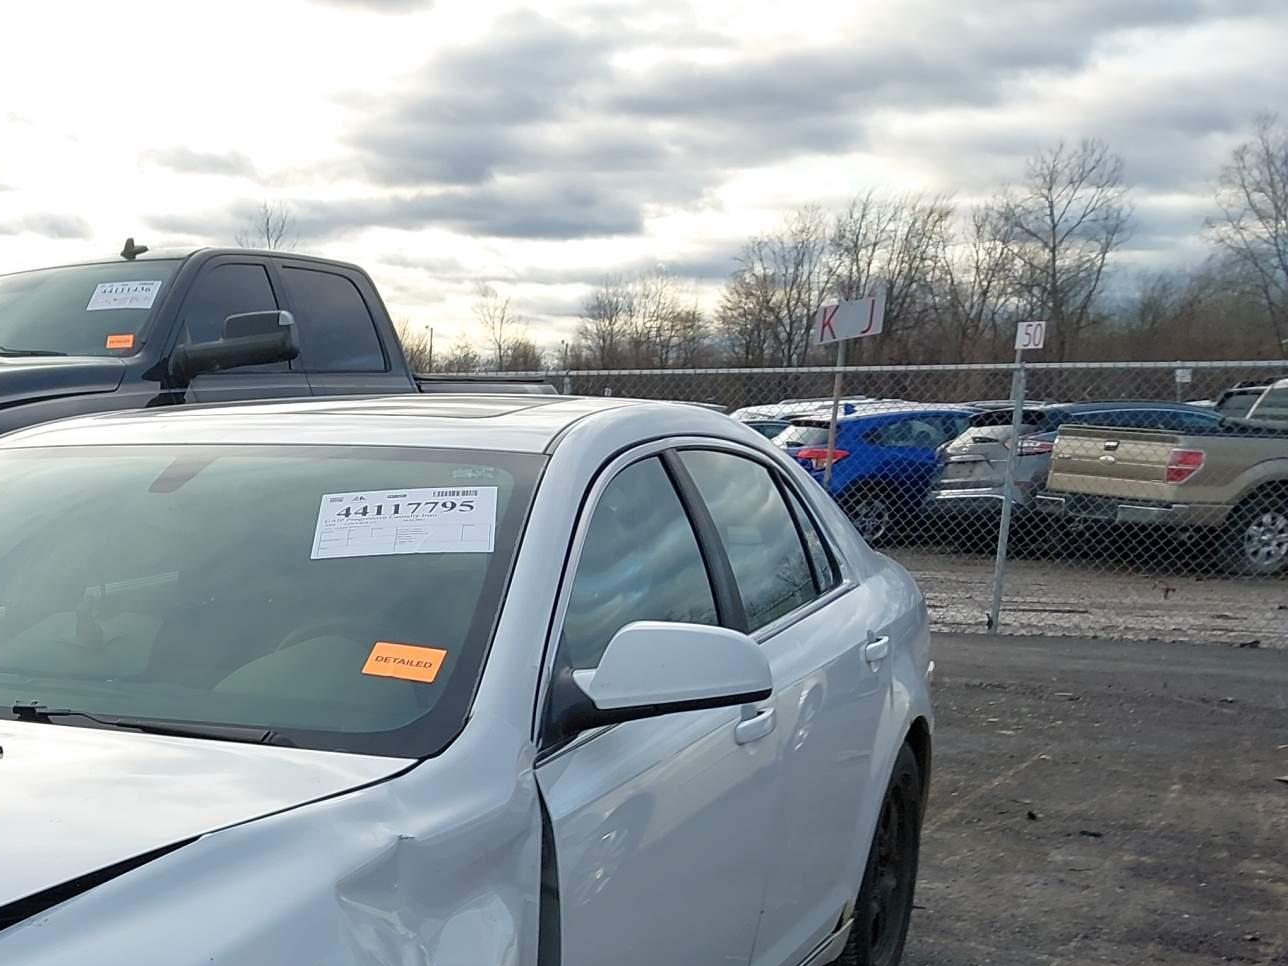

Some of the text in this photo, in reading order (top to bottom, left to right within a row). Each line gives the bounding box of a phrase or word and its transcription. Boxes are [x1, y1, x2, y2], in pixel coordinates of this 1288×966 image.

[820, 299, 875, 342] K J
[1022, 323, 1043, 347] 50
[336, 500, 475, 518] 44117795
[374, 655, 433, 669] DETAILED
